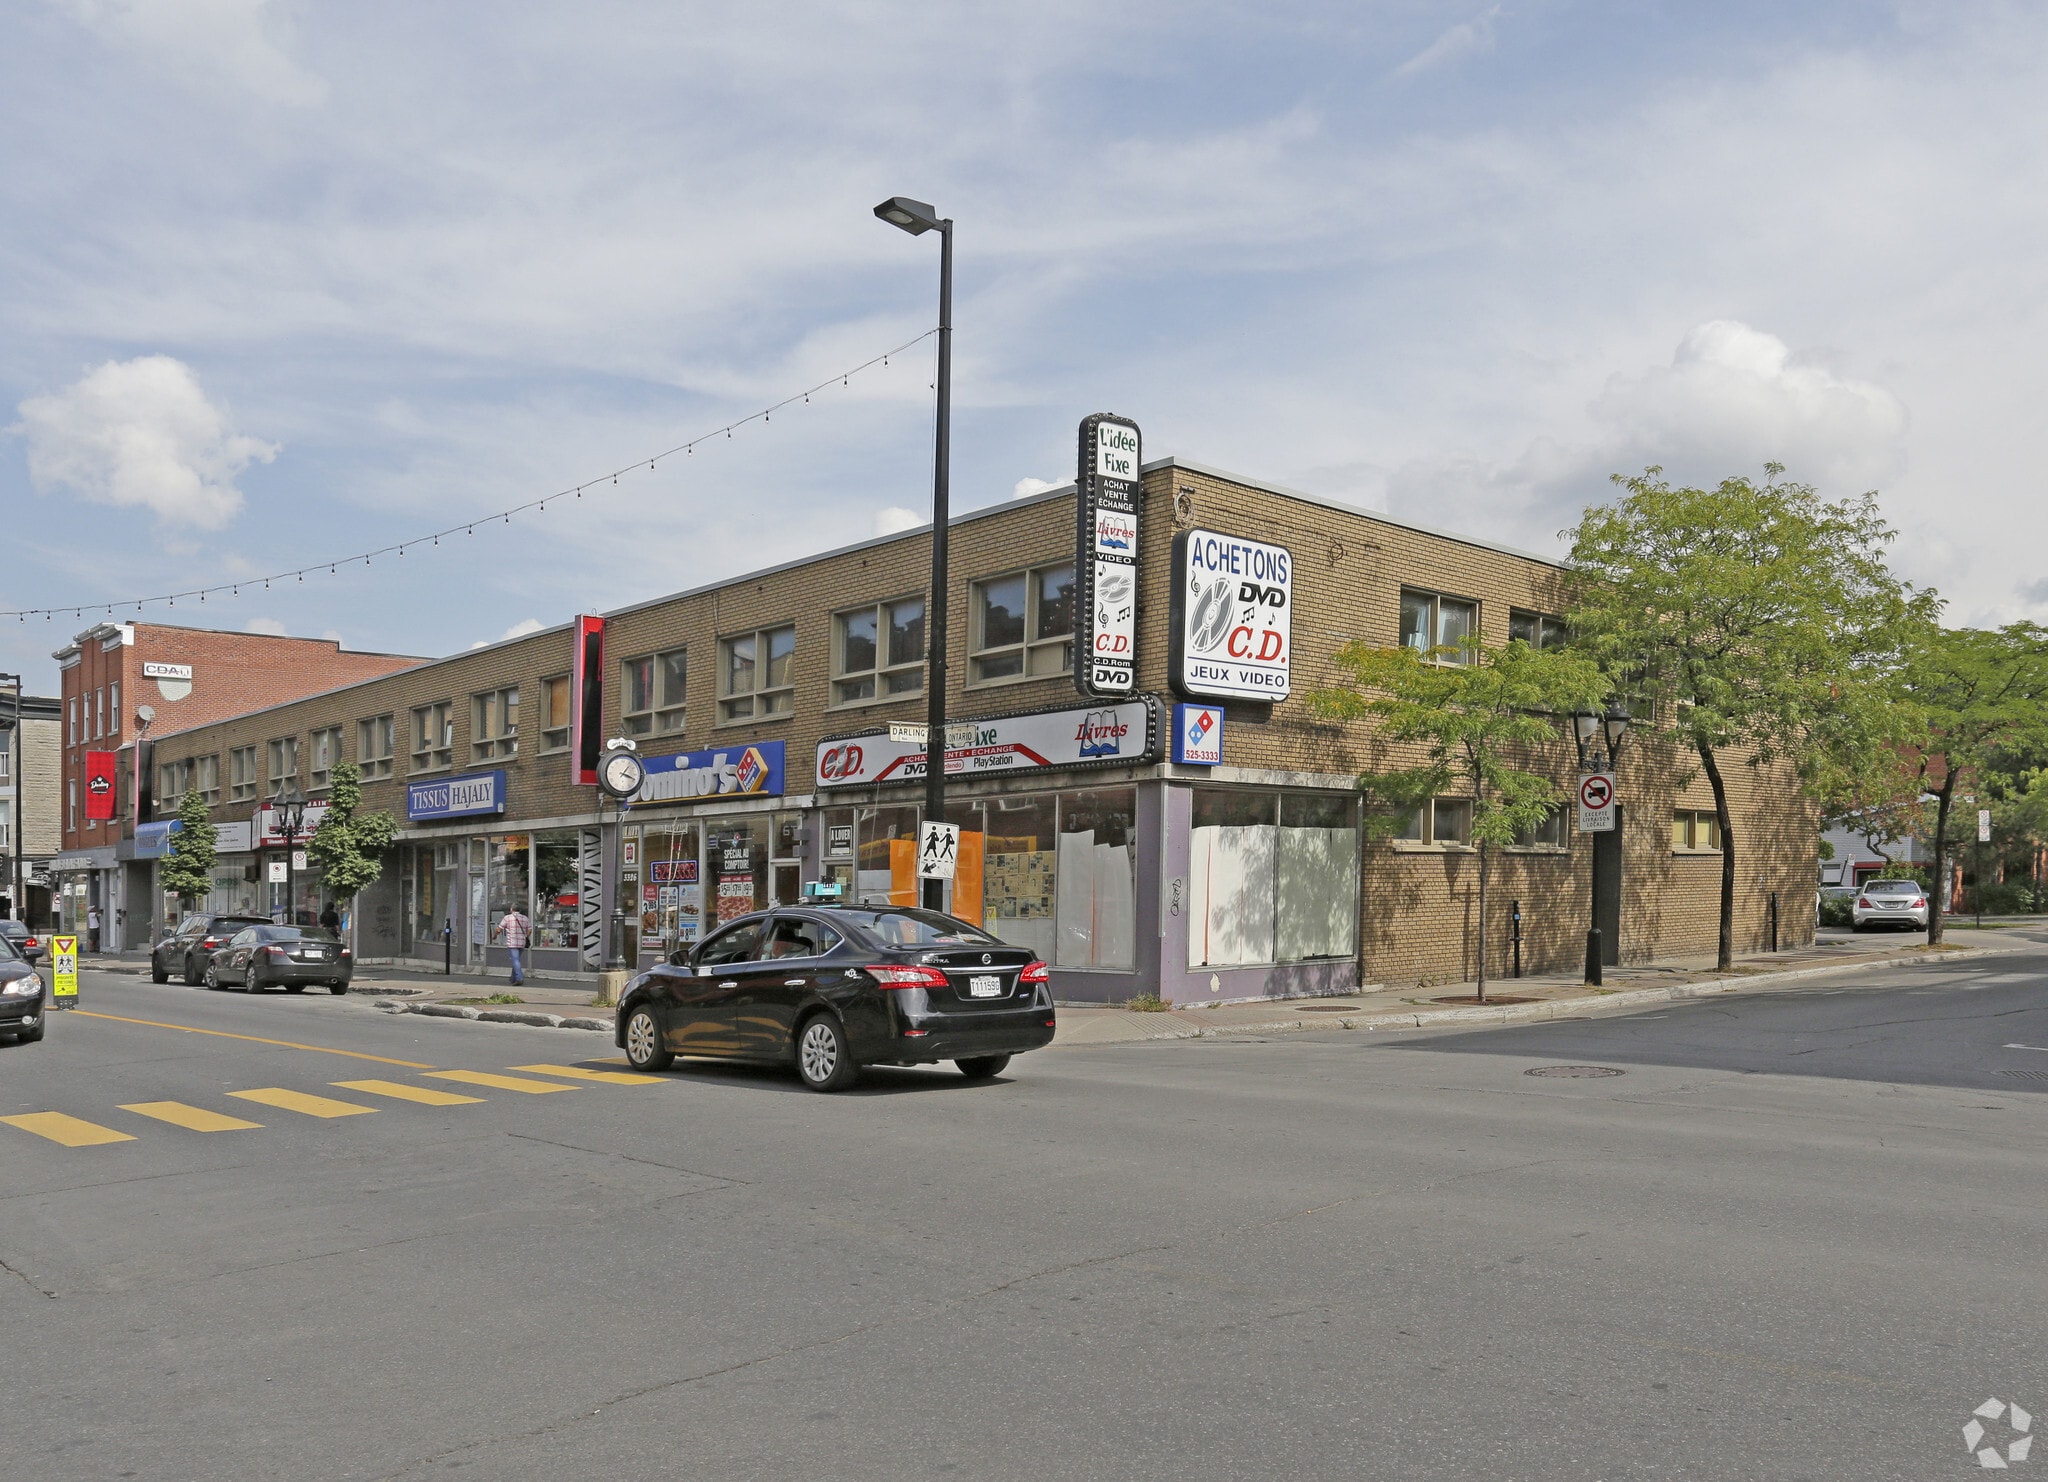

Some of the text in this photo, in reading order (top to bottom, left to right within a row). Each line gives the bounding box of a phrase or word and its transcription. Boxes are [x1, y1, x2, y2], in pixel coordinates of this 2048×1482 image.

[1100, 427, 1136, 452] L'idée
[1104, 452, 1129, 475] Fixe
[1103, 479, 1129, 491] ACHAT
[1104, 489, 1128, 501] VENTE
[1097, 521, 1135, 539] Livres
[1096, 553, 1132, 564] VIDEO
[1192, 537, 1288, 584] ACHETONS
[1238, 582, 1286, 608] DVD
[1095, 633, 1130, 653] C.D.
[1227, 625, 1286, 664] C.D.
[1093, 657, 1131, 668] C.D.Rom
[1095, 669, 1129, 684] DVD
[1190, 665, 1285, 687] JEUX VIDEO
[892, 727, 925, 737] DARLING
[1075, 722, 1128, 742] Livres
[820, 746, 865, 780] C.D.
[973, 754, 1013, 768] PlayStation
[1185, 750, 1219, 761] 525-3333
[412, 782, 493, 809] TISSUS HAJALY
